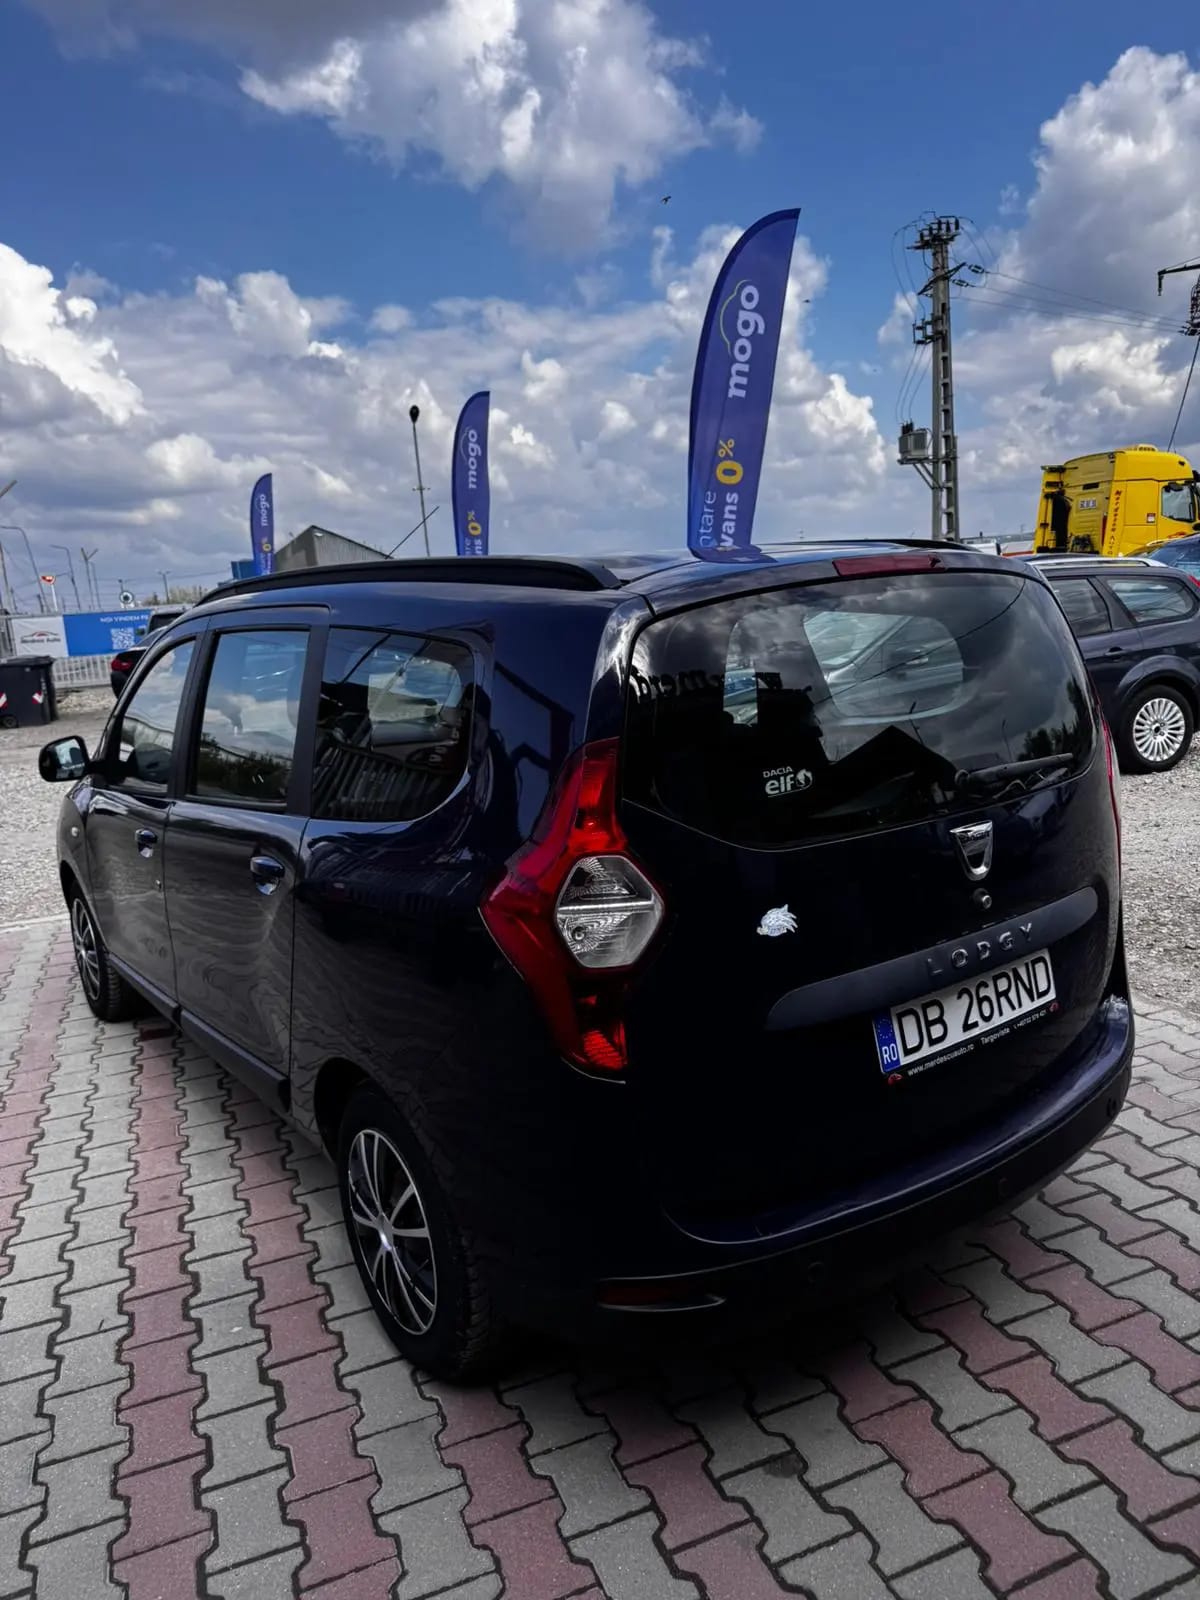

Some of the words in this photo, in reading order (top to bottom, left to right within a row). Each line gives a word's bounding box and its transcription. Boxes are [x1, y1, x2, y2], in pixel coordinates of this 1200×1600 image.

[727, 284, 765, 398] mogo
[468, 429, 482, 489] mogo
[716, 438, 744, 485] 0%
[260, 493, 270, 527] mogo
[762, 766, 793, 778] DACIA
[765, 774, 795, 795] elf
[927, 922, 1033, 975] LODGY
[896, 999, 948, 1058] DB
[881, 1043, 898, 1065] RO
